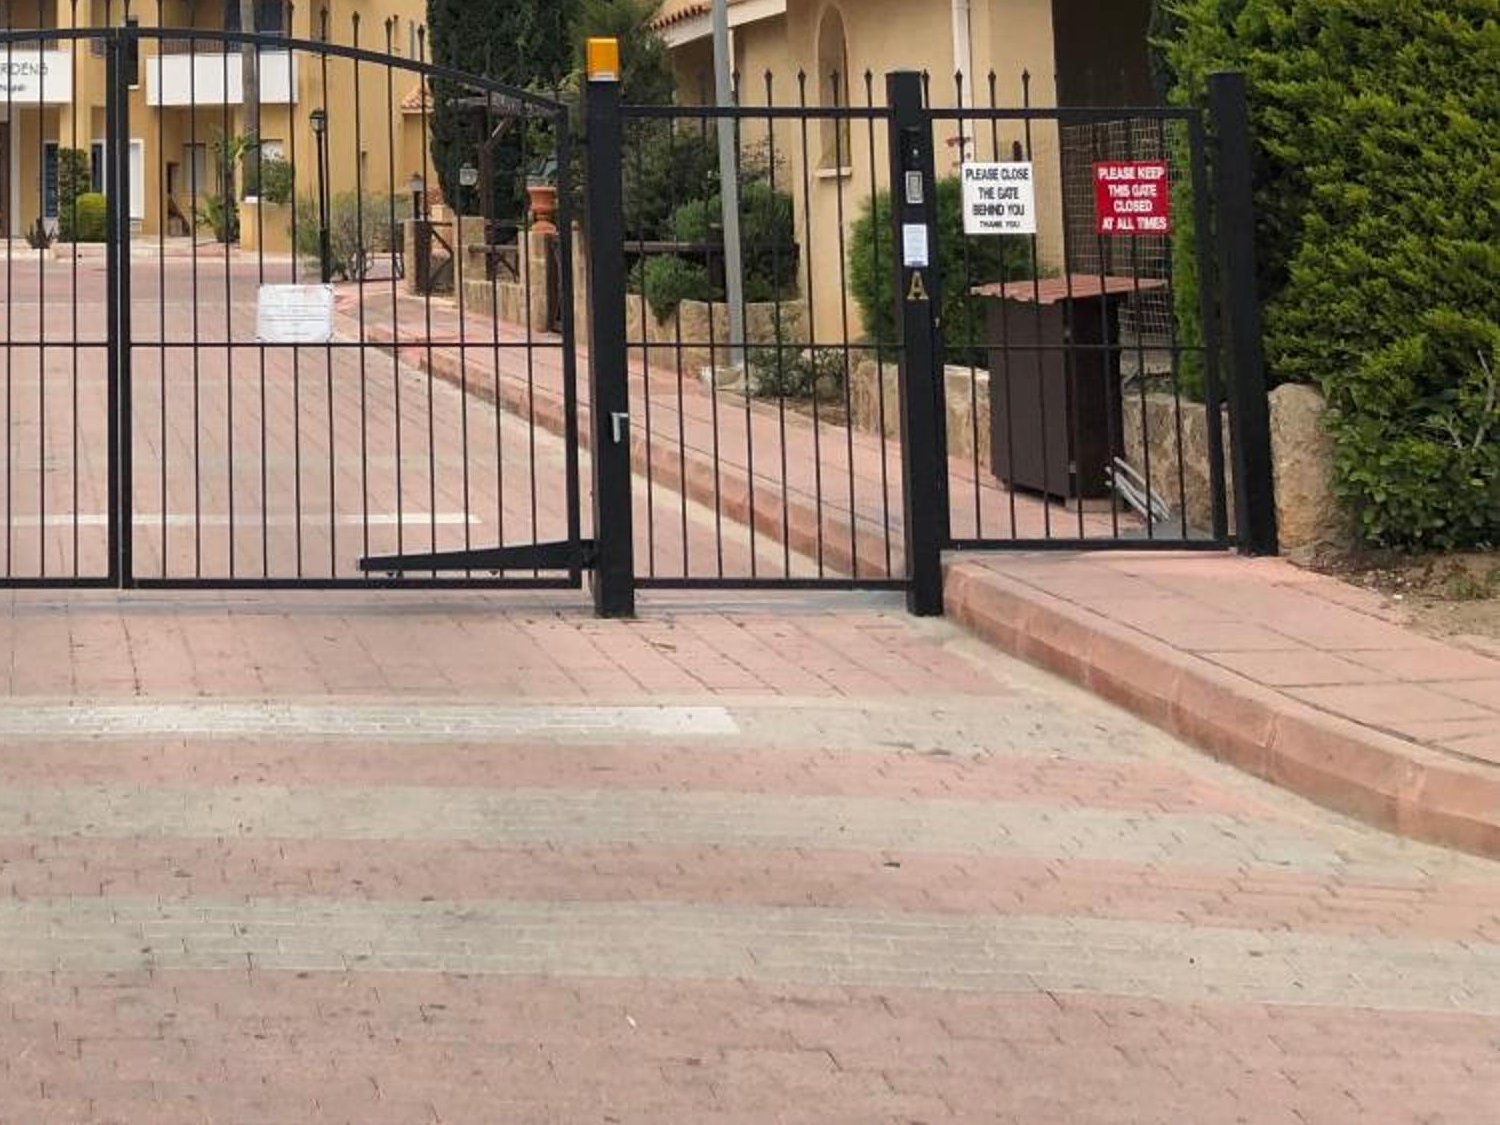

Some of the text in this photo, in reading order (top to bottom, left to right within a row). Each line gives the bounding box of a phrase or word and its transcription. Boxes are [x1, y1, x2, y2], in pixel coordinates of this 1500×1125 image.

[965, 168, 1029, 180] PLEASE CLOSE
[1098, 166, 1165, 180] PLEASE KEEP
[978, 187, 1019, 200] THE GATE
[1108, 184, 1157, 197] THIS GATE
[973, 204, 1025, 216] BEHIND YOU
[1113, 199, 1153, 212] CLOSED
[1102, 216, 1167, 230] AT ALL TIMES
[906, 270, 929, 300] A
